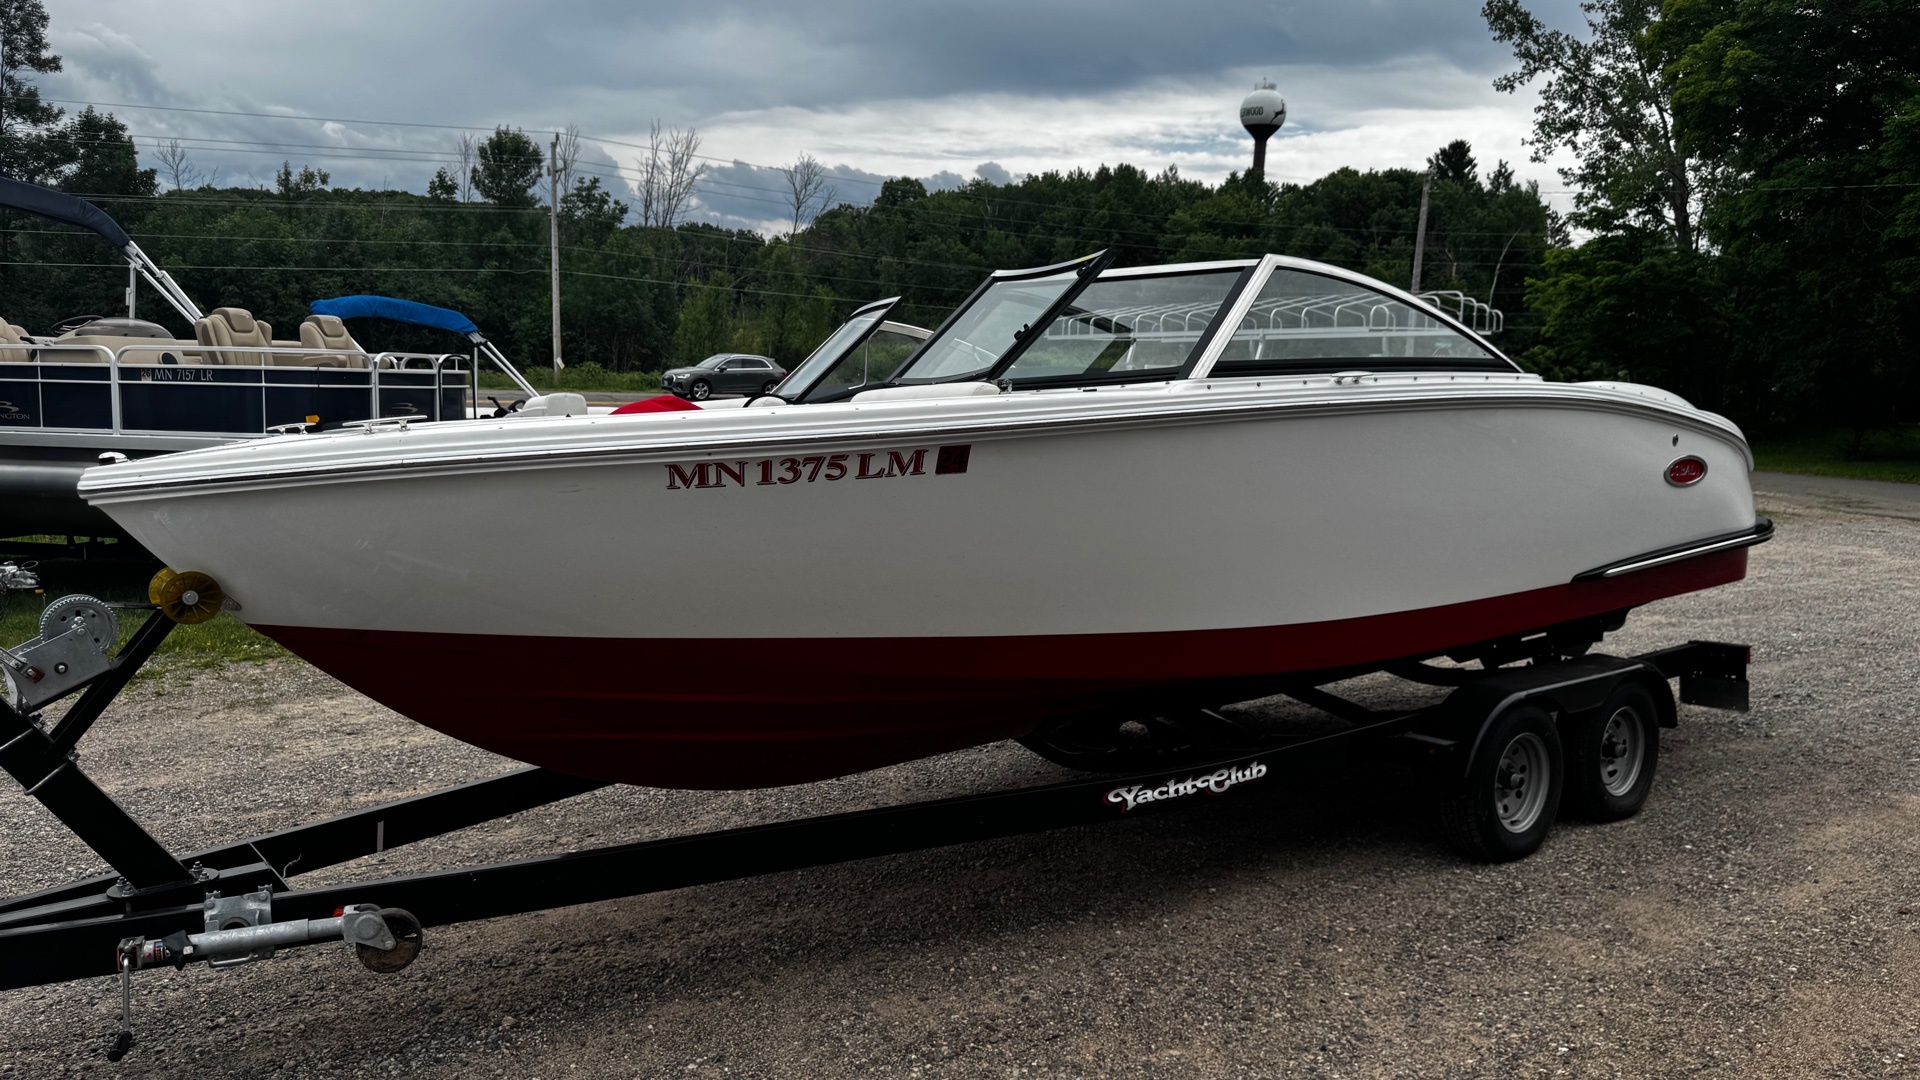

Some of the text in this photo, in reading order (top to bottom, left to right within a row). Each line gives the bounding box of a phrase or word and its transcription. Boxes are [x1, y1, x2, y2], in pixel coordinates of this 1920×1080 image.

[154, 369, 214, 381] MN 7157 LR
[665, 449, 929, 490] MN 1375 LM
[1105, 760, 1267, 811] Yacht Club
